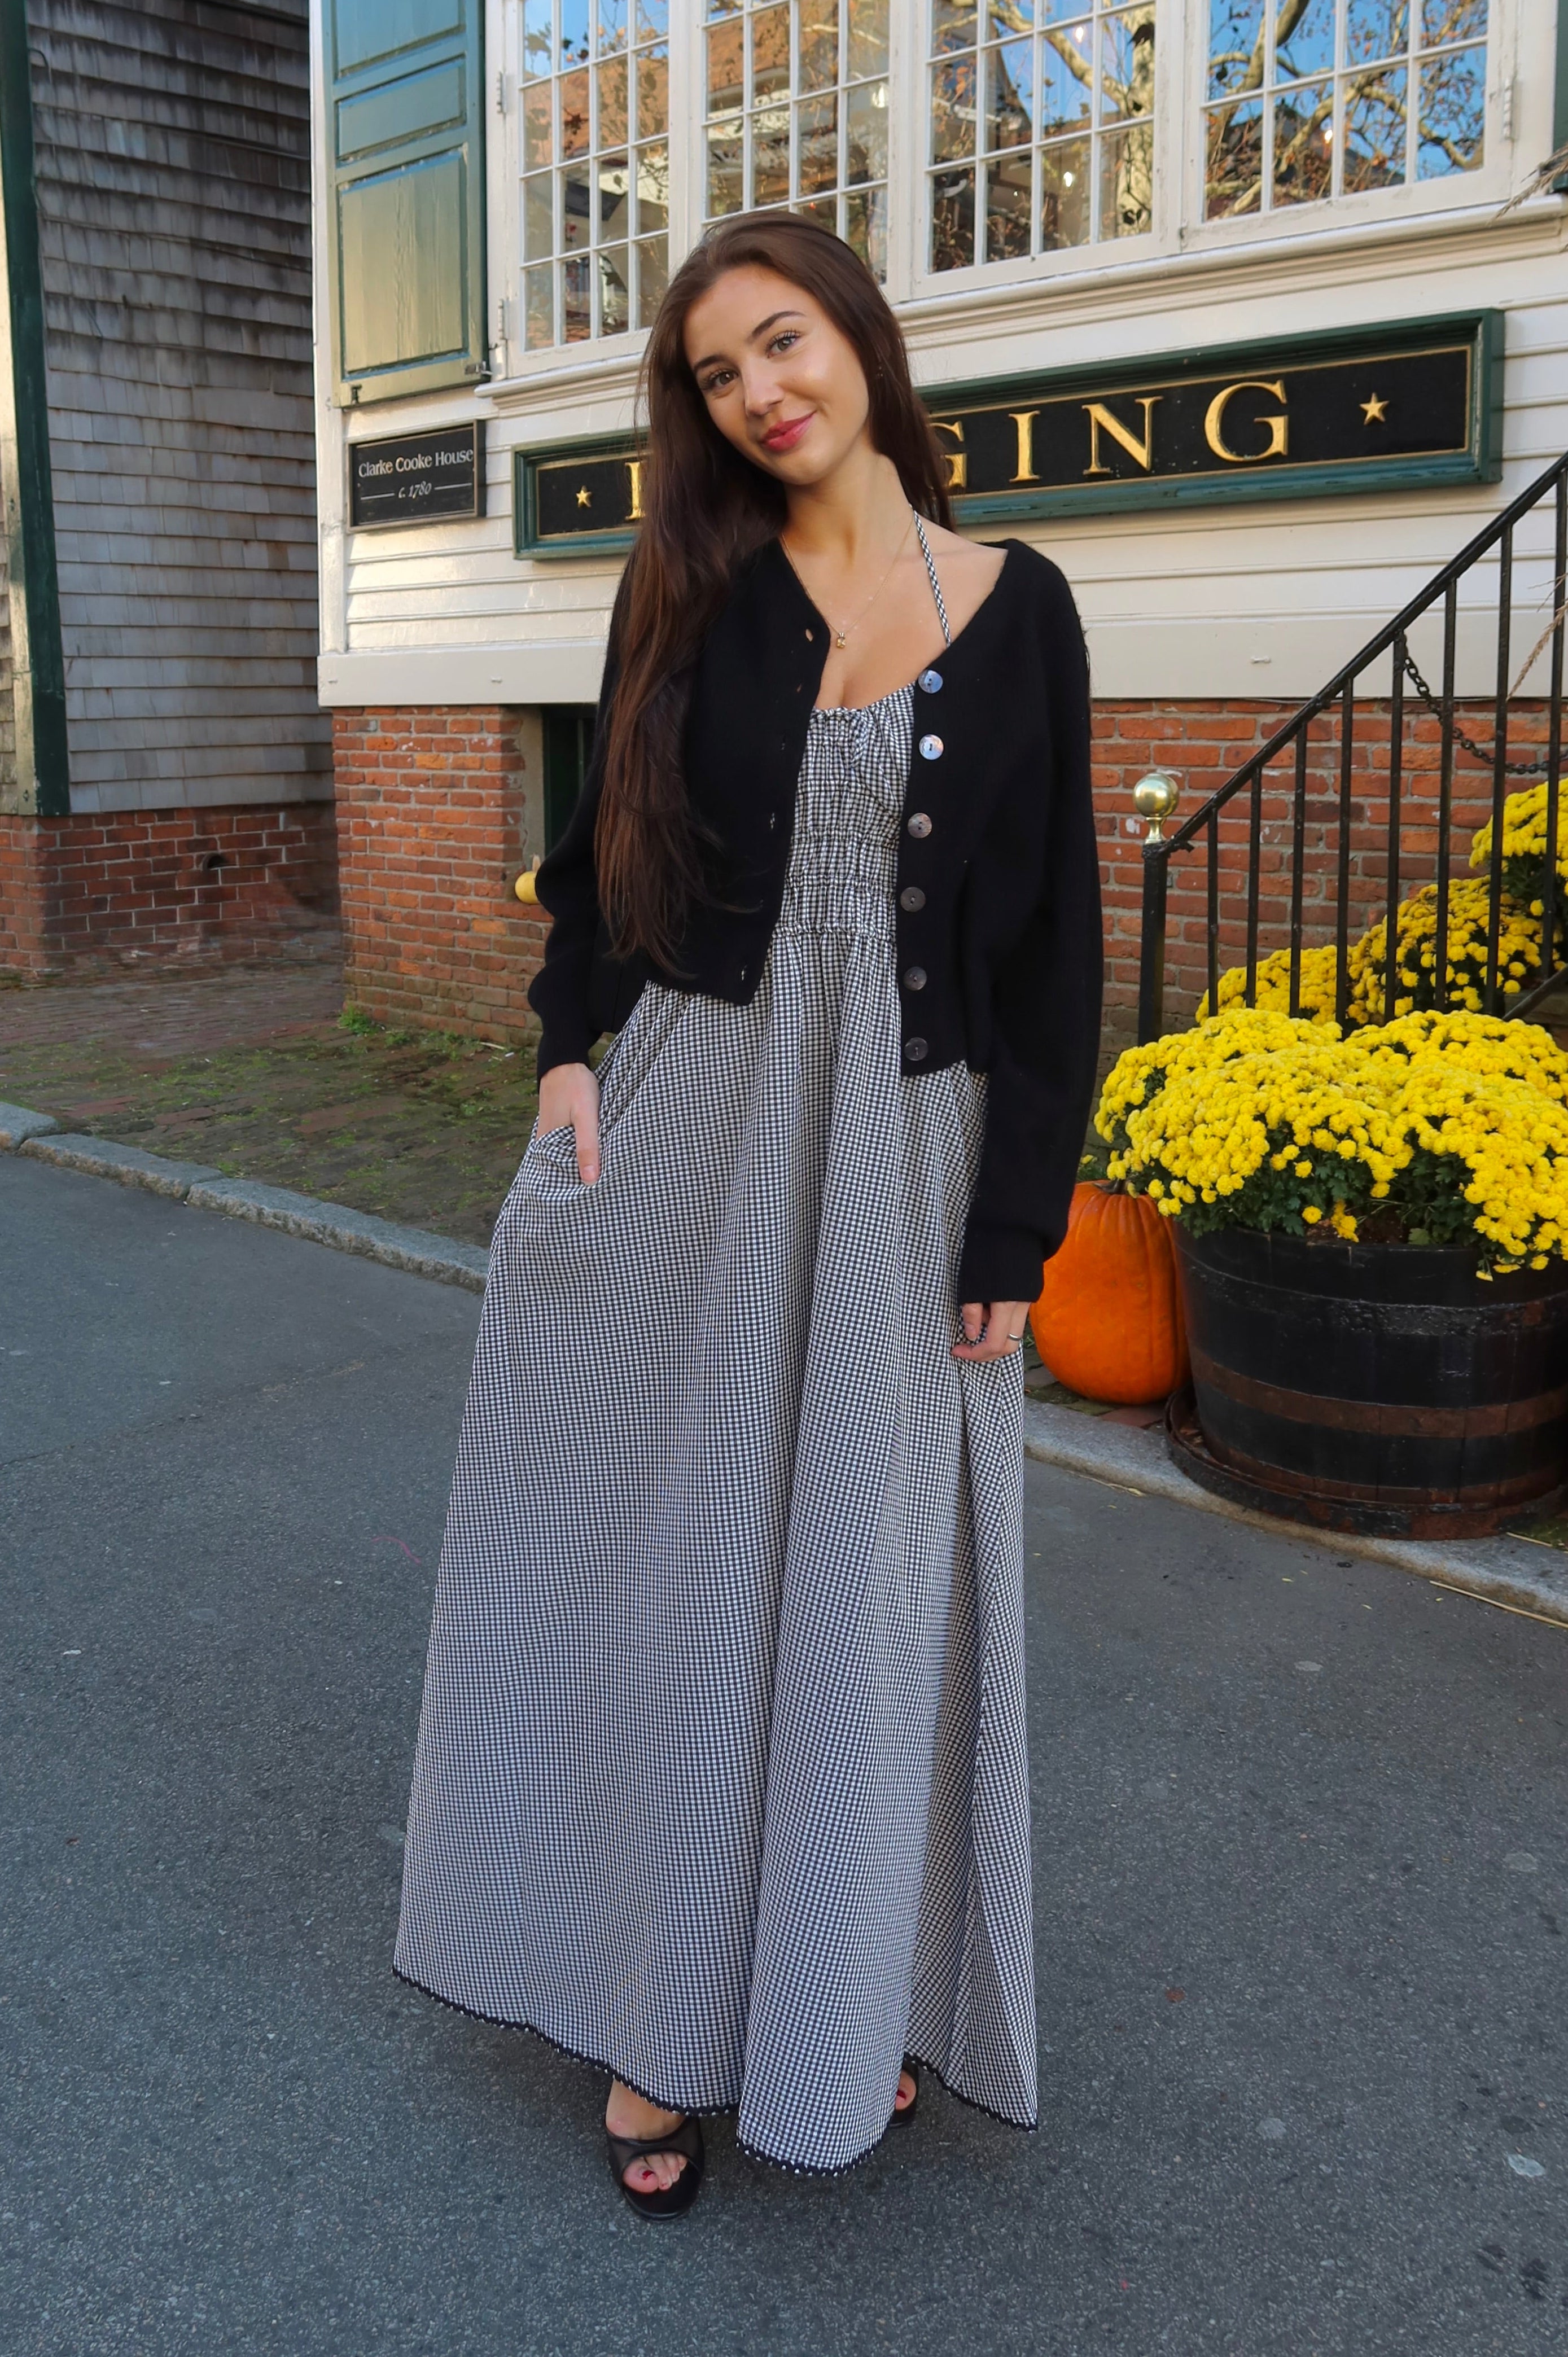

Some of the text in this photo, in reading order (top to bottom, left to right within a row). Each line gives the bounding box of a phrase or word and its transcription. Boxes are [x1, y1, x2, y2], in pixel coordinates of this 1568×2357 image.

[358, 449, 474, 477] Clarke Cooke House
[625, 379, 1289, 520] GING
[408, 481, 432, 500] 1780
